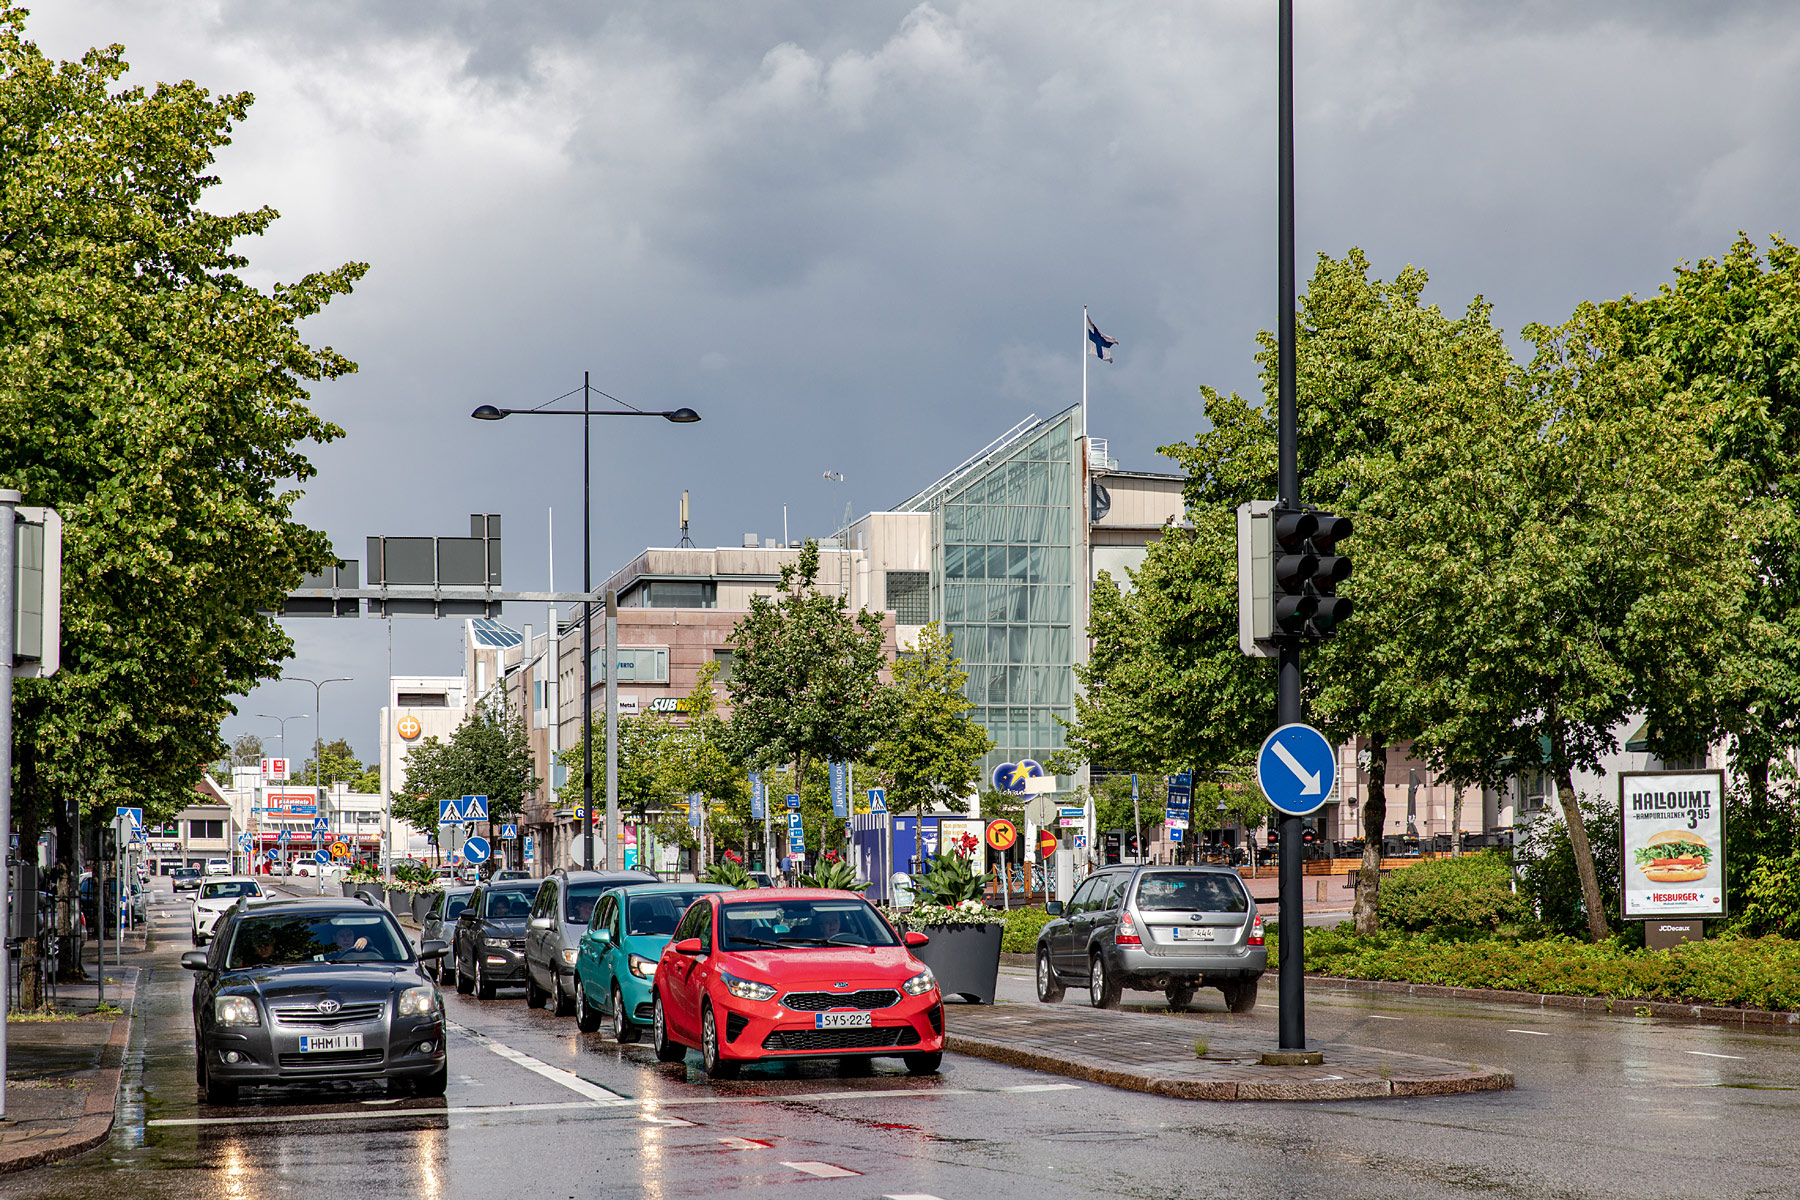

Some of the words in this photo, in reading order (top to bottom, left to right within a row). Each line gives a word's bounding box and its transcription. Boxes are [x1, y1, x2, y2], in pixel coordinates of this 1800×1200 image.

[1632, 790, 1711, 810] HALLOUMI
[790, 814, 799, 828] P
[1653, 892, 1699, 903] HESBURGER
